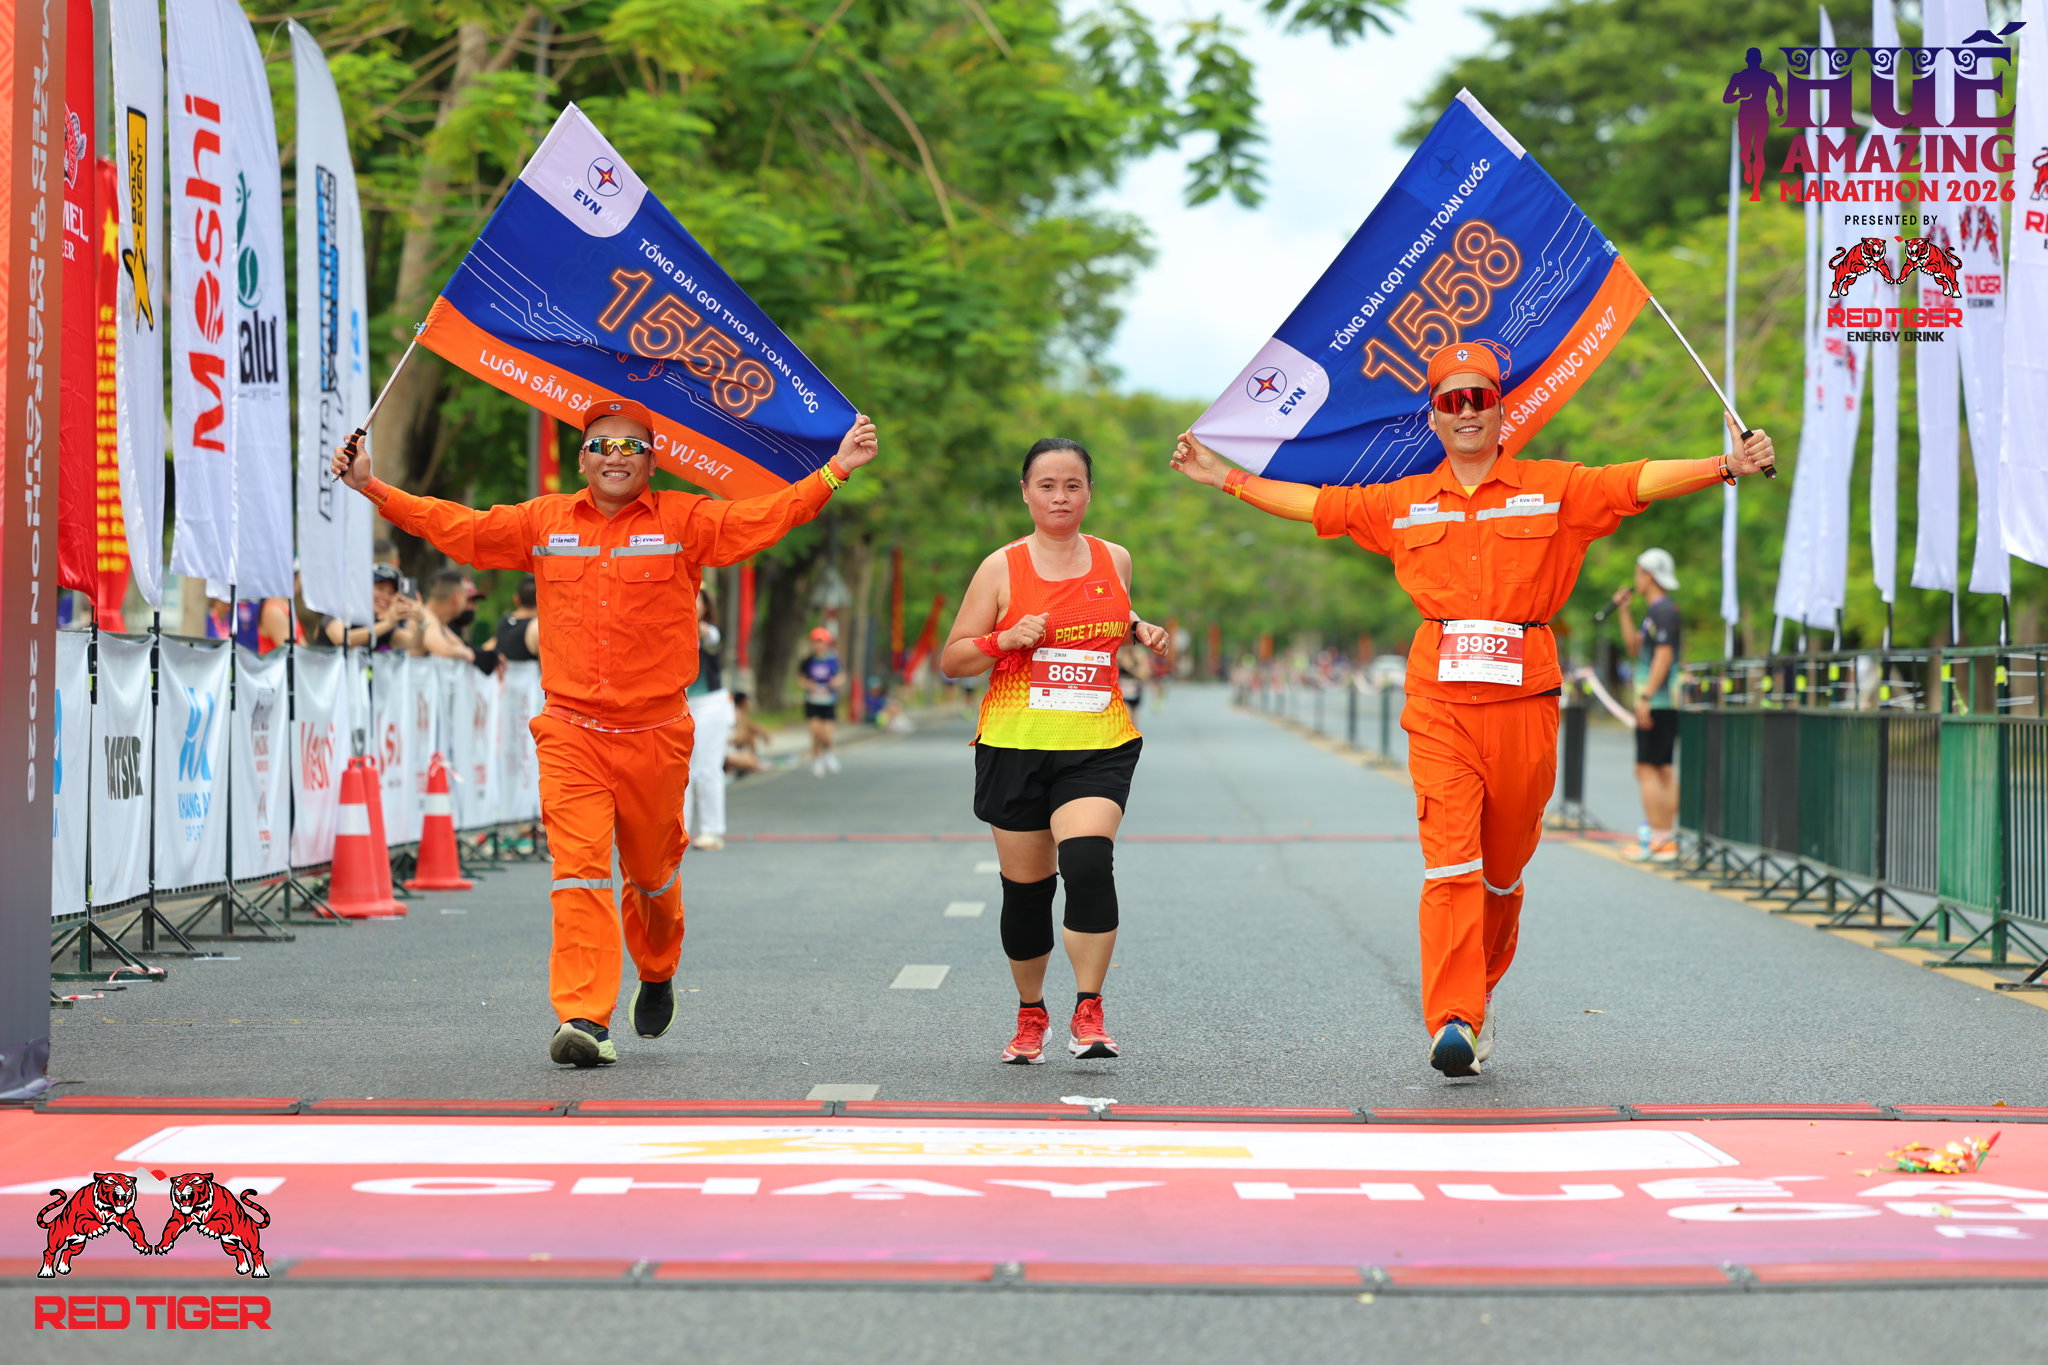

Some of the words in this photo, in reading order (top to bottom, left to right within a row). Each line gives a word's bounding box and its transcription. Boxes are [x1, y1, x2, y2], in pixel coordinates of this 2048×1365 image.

[31, 65, 41, 190] RED
[130, 150, 138, 224] BOLT
[136, 137, 144, 228] EVENT
[573, 188, 602, 215] EVN
[1360, 291, 1386, 318] ĐÀI
[1380, 267, 1406, 293] GỌI
[1398, 228, 1437, 270] THOẠI
[1430, 194, 1464, 231] TOÀN
[1458, 158, 1491, 197] QUỐC
[26, 203, 39, 380] TIGER
[597, 268, 777, 420] 1558
[673, 270, 698, 294] ĐÀI
[696, 290, 721, 314] GỌI
[721, 309, 760, 346] THOẠI
[760, 342, 792, 377] TOÀN
[791, 375, 819, 414] QUỐC
[1361, 219, 1521, 393] 1558
[479, 350, 529, 384] LUÔN
[1279, 387, 1306, 416] EVN
[1510, 386, 1551, 425] SÀNG
[1544, 351, 1584, 393] PHỤC
[1577, 331, 1600, 357] VỤ
[1595, 305, 1617, 340] 24/7
[24, 394, 35, 528] CUP
[31, 258, 46, 625] MARATHON
[670, 440, 695, 465] VỤ
[694, 454, 734, 481] 24/7
[1048, 664, 1098, 683] 8657
[1055, 624, 1086, 643] PACE
[1095, 621, 1129, 638] FAMILY
[1456, 635, 1509, 654] 8982
[27, 639, 39, 804] 2026
